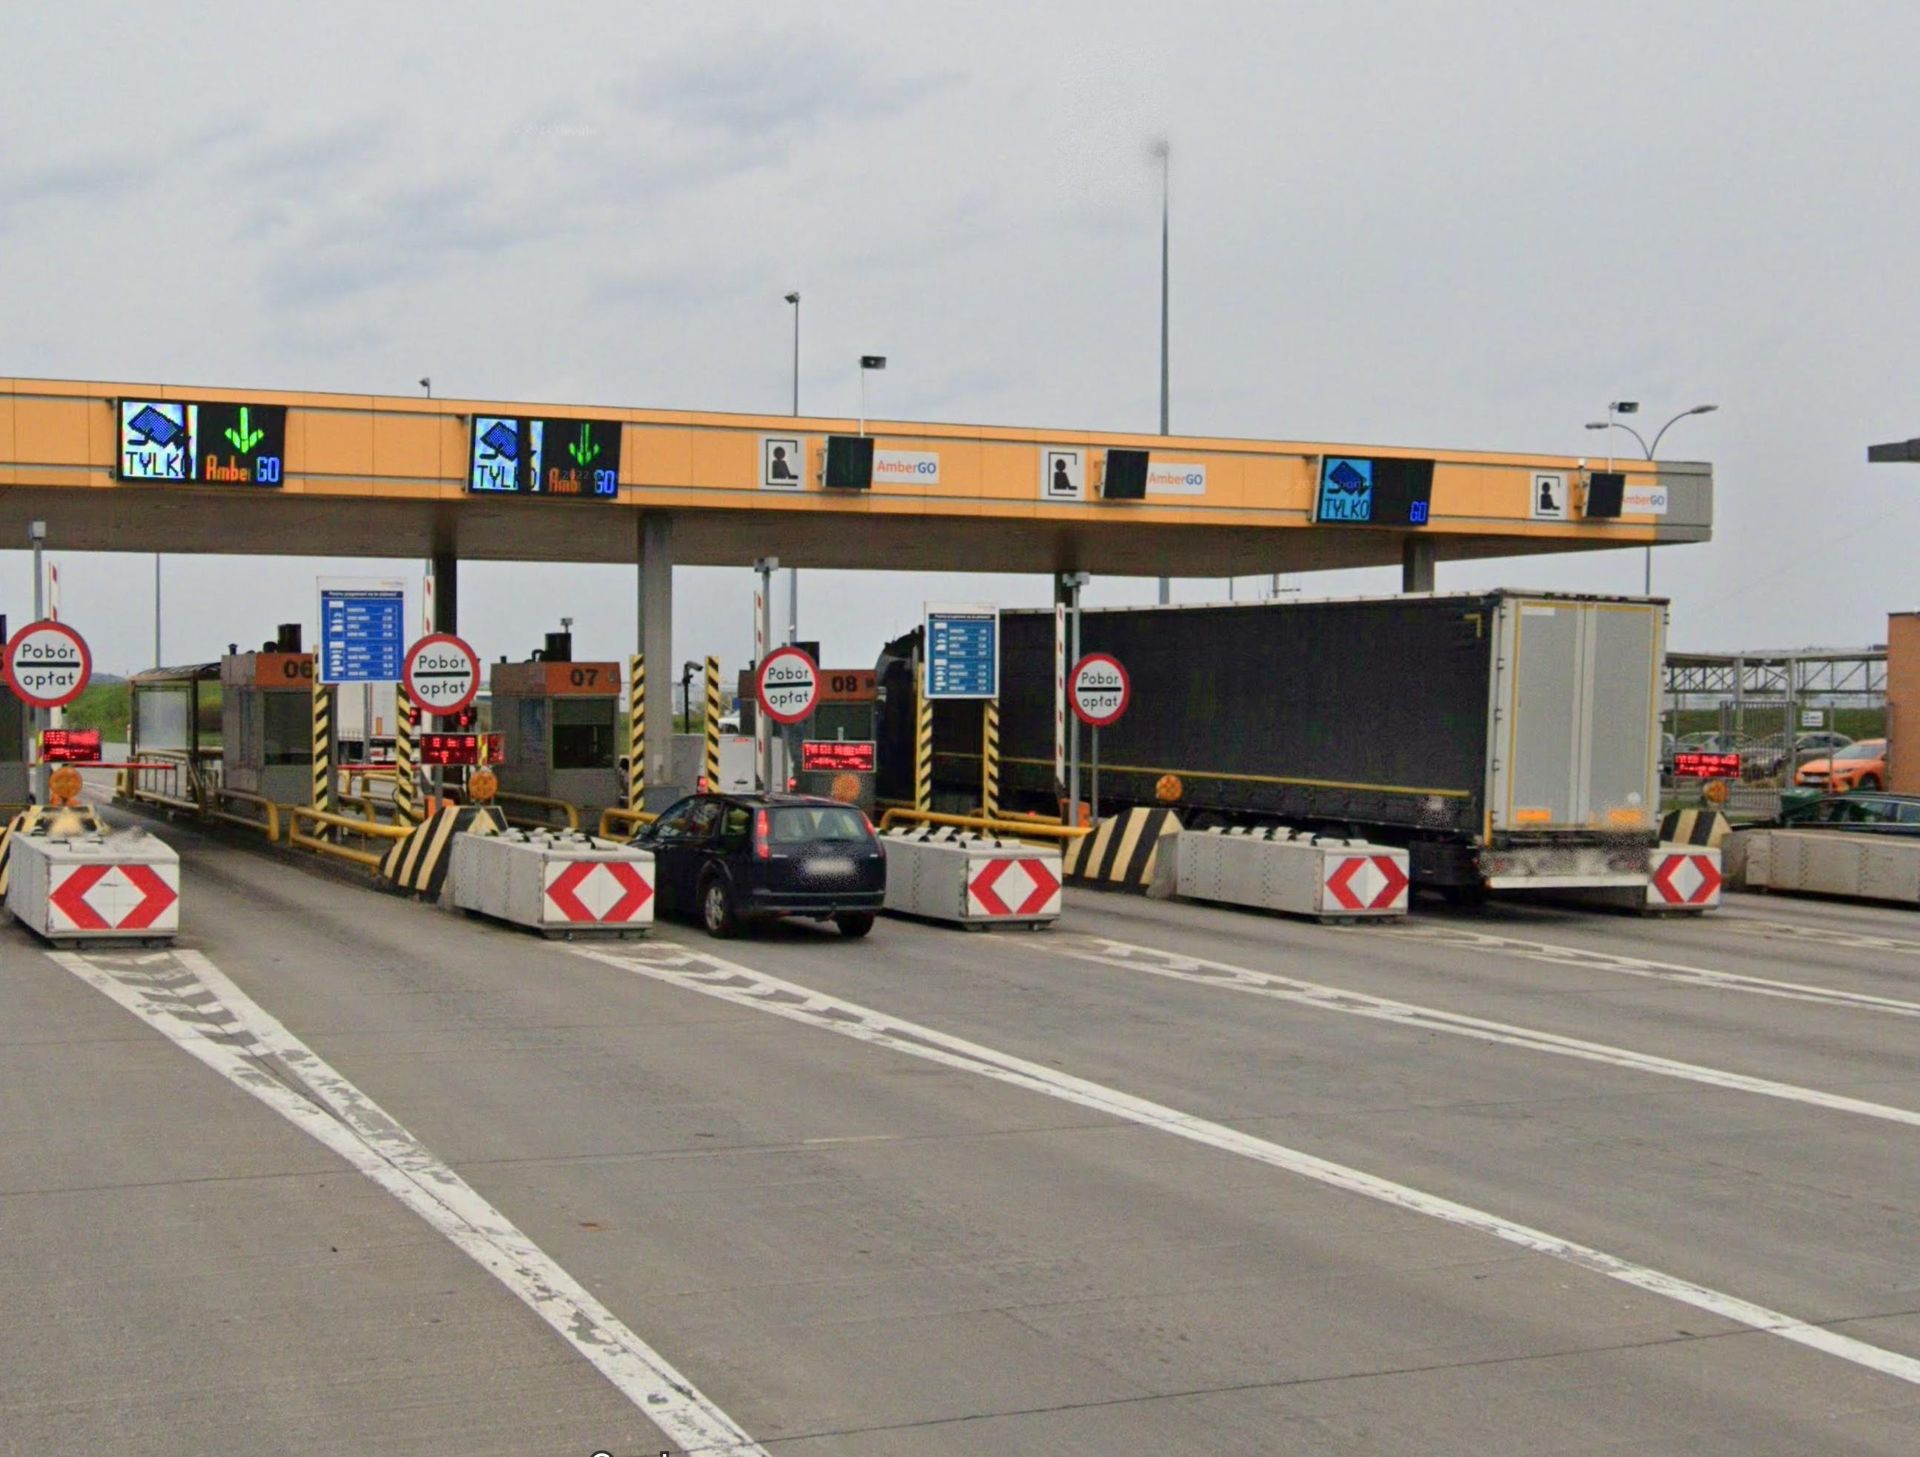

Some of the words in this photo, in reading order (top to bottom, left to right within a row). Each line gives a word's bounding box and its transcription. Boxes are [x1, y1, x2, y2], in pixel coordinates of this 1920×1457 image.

[876, 459, 936, 475] AmberGO
[1148, 470, 1203, 486] AmberGO
[1324, 498, 1370, 518] TYLKO
[22, 642, 76, 659] Pobór
[418, 653, 467, 669] Pobór
[23, 670, 75, 690] opłat
[570, 668, 599, 687] 07
[768, 664, 809, 680] Pobór
[419, 680, 466, 699] opłat
[831, 675, 858, 693] 08
[769, 690, 809, 708] opłat
[1081, 695, 1118, 712] opłat
